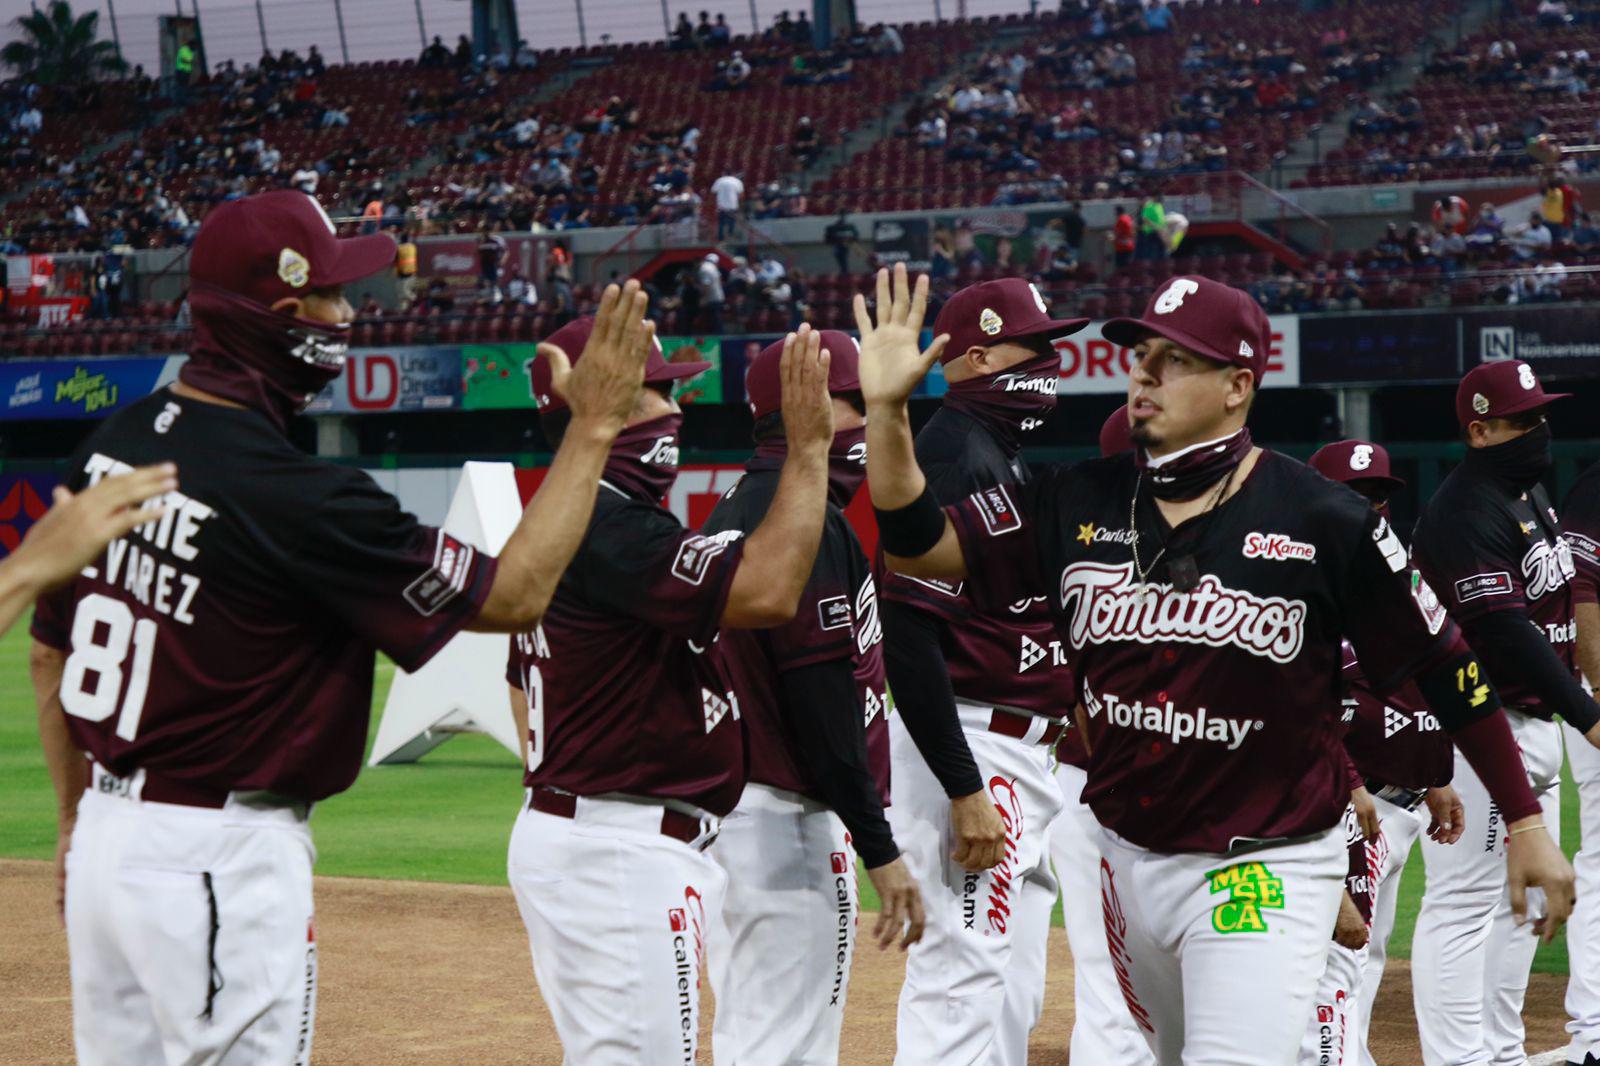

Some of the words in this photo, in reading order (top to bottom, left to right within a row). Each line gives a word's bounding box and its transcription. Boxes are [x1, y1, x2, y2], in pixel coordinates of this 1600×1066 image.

[1093, 527, 1127, 543] Carl's
[1244, 534, 1314, 559] SuKarne
[1061, 561, 1307, 664] Tomateros
[60, 593, 158, 742] 81
[1456, 661, 1479, 692] 19
